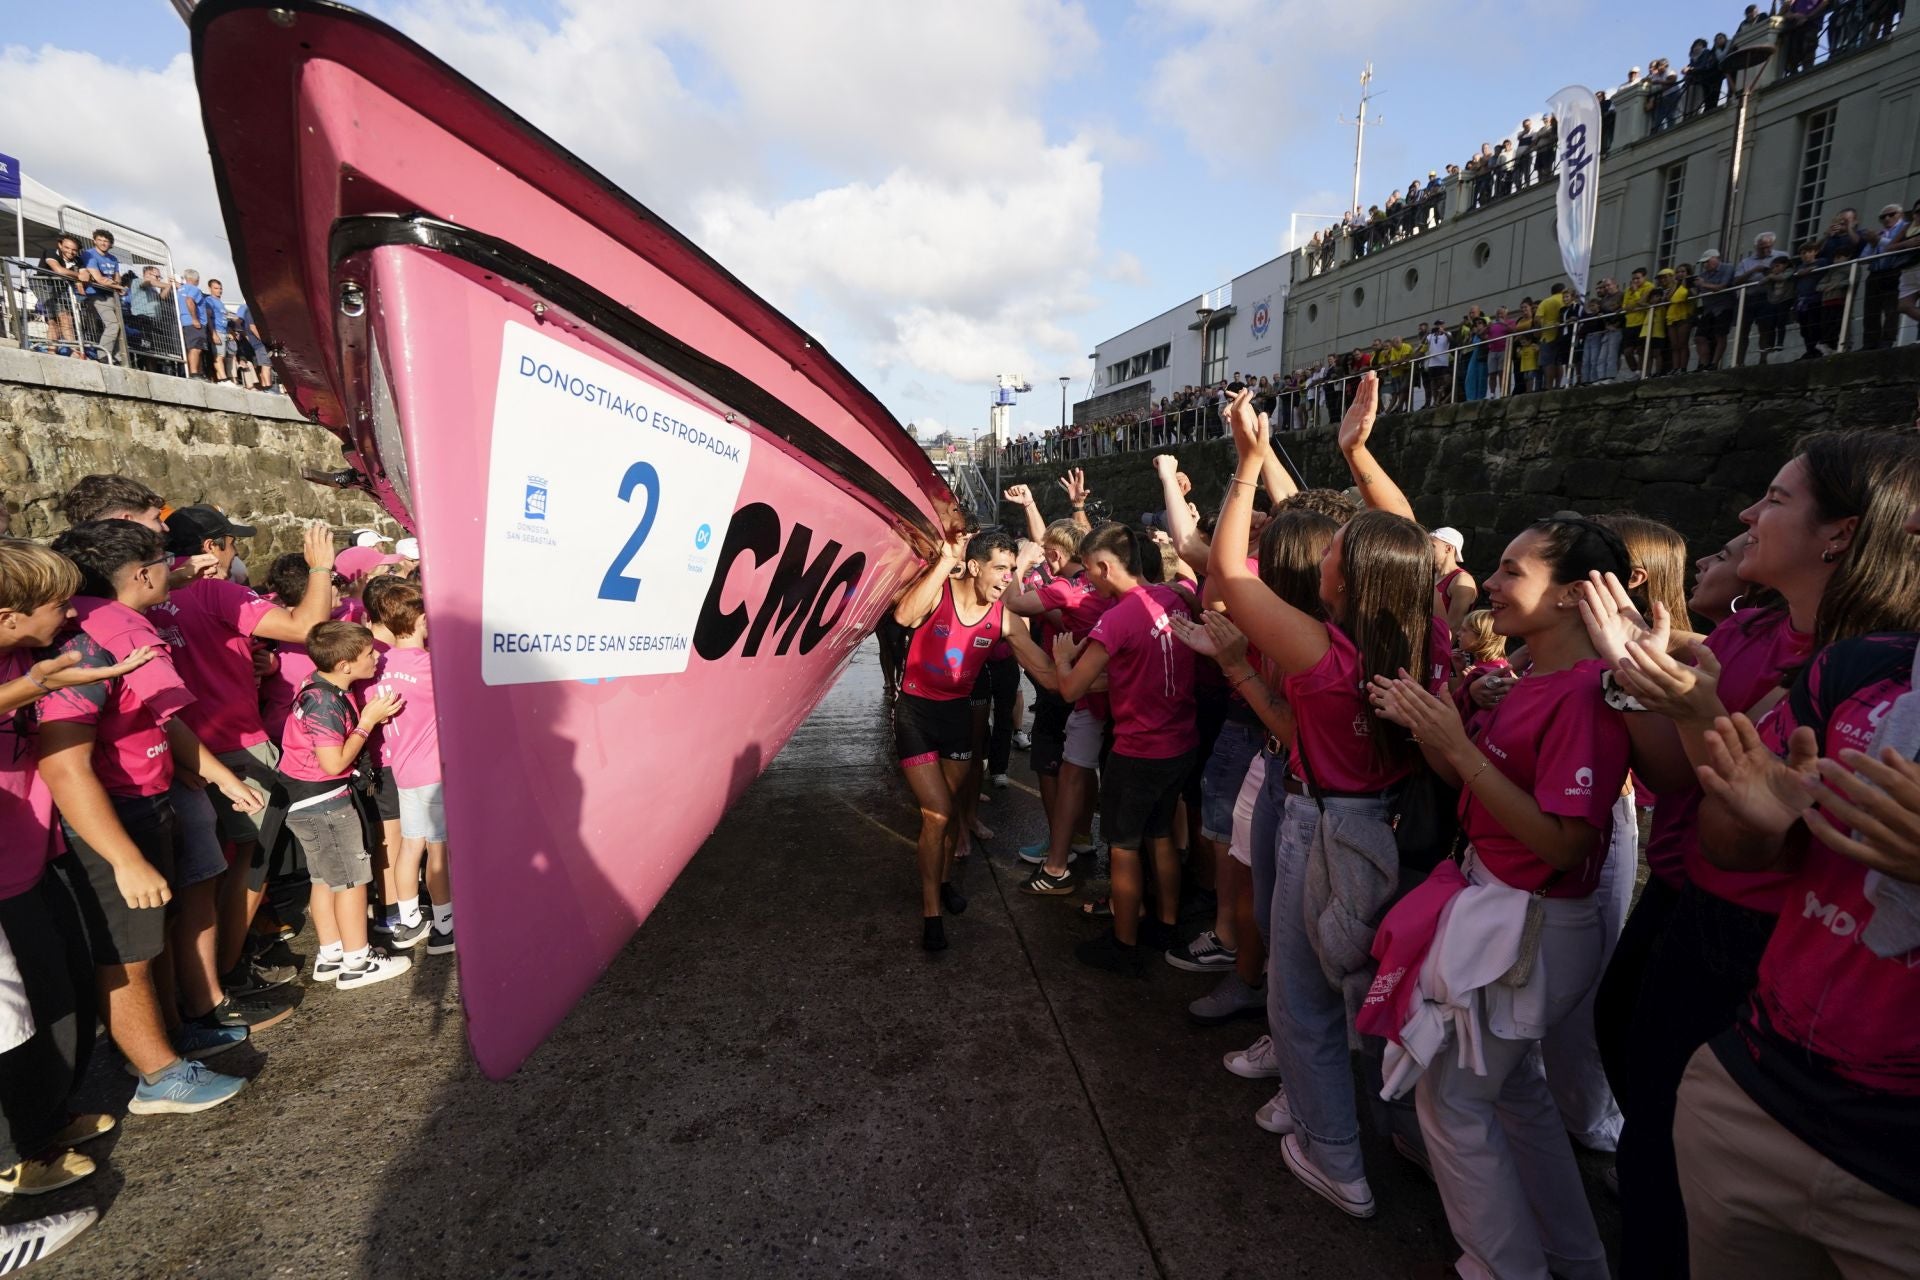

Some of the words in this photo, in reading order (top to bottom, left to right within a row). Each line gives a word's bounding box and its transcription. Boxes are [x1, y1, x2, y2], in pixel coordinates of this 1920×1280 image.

[520, 355, 648, 423] DONOSTIAKO
[652, 411, 741, 464] ESTROPADAK
[597, 460, 660, 603] 2
[693, 501, 867, 661] CMO
[493, 633, 572, 653] REGATAS
[576, 634, 596, 651] DE
[599, 635, 626, 651] SAN
[628, 632, 688, 651] SEBASTIÁN
